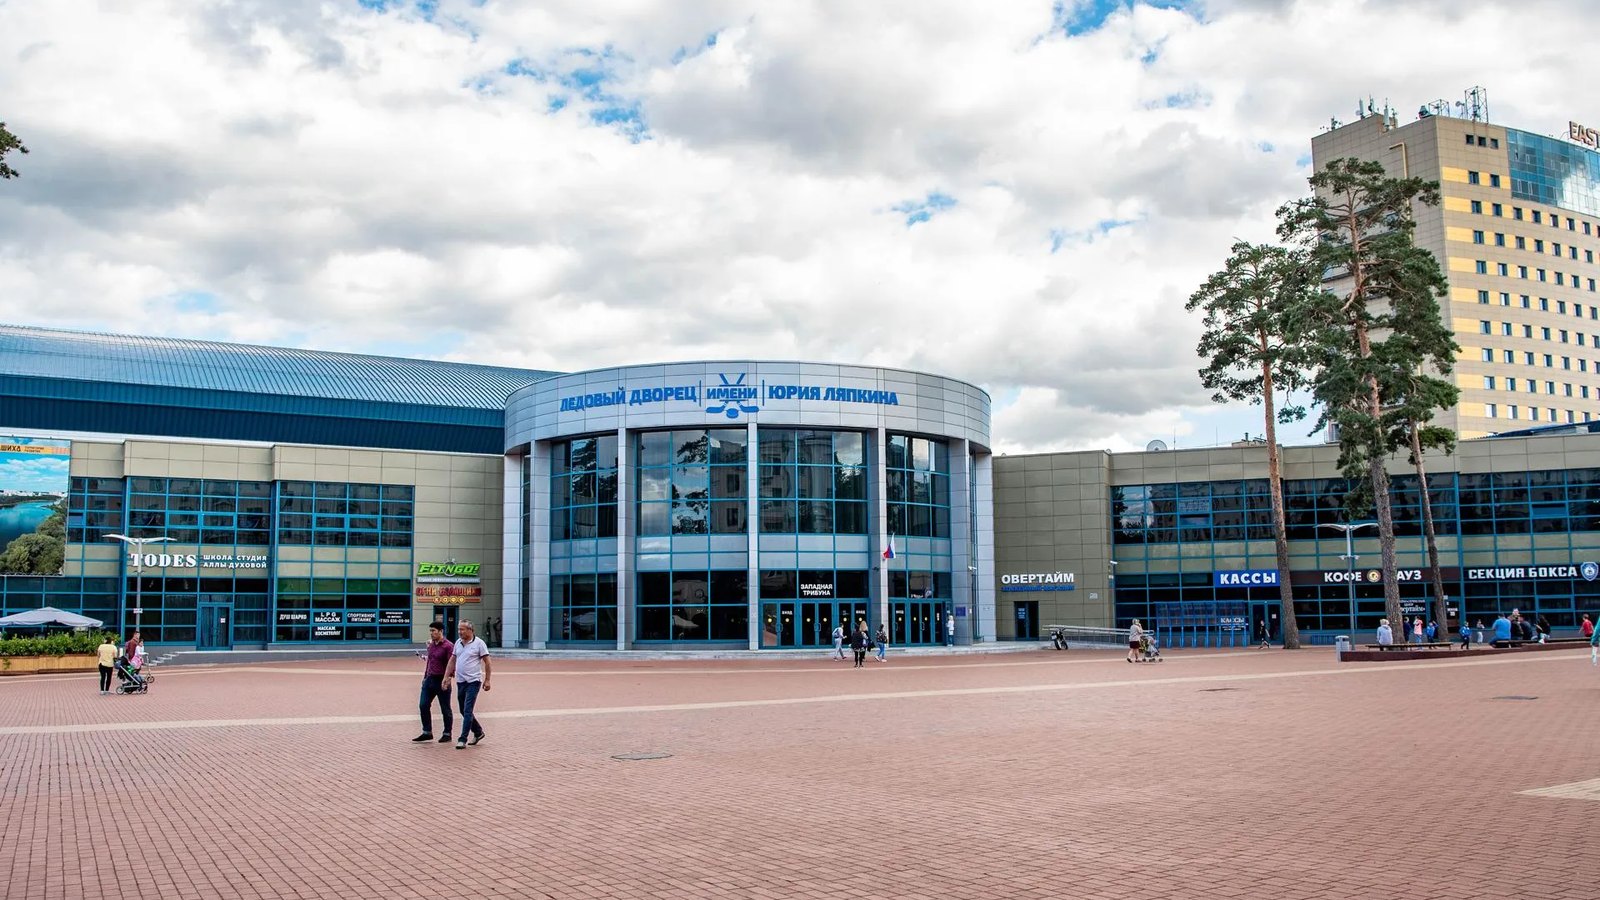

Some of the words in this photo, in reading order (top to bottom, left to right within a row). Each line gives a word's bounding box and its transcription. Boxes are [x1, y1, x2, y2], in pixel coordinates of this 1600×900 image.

[560, 386, 626, 412] ЛЕДОВЫЙ
[629, 385, 697, 406] ДВОРЕЦ
[706, 387, 758, 400] ИМЕНИ
[768, 385, 821, 400] ЮРИЯ
[823, 387, 899, 406] ЛЯПКИНА
[130, 553, 197, 568] TODES
[228, 561, 267, 569] ДУХОВОЙ
[1001, 571, 1074, 584] ОВЕРТАЙМ
[1220, 572, 1276, 584] КАССЫ
[1324, 571, 1362, 583] КОФЕ
[1395, 570, 1422, 581] АУЗ
[1468, 567, 1525, 579] СЕКЦИЯ
[1528, 566, 1578, 578] БОКСА
